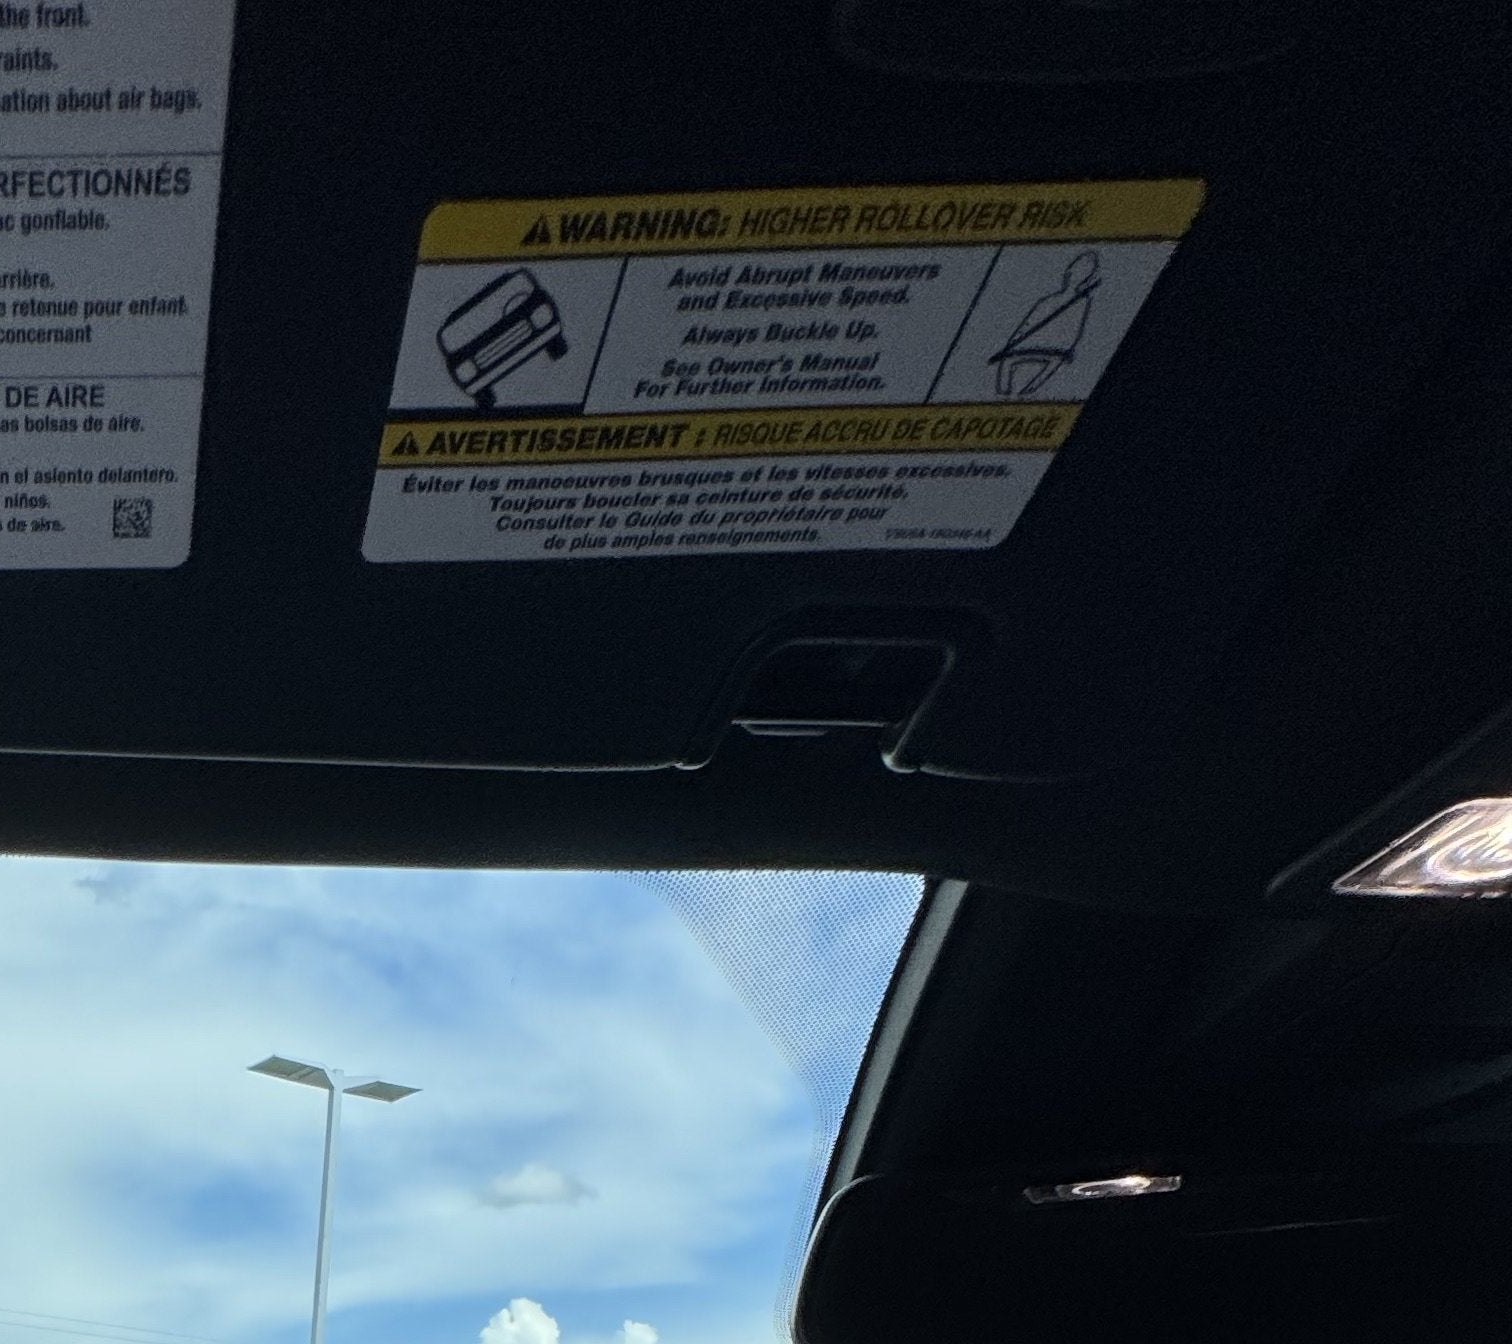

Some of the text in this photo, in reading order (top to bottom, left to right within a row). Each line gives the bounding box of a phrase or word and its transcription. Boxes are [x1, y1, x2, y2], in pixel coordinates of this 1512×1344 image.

[36, 2, 88, 30] front.
[56, 88, 112, 114] about
[117, 87, 143, 112] air
[149, 87, 201, 114] bags.
[558, 199, 1087, 243] WARNING: HIGHER ROLLOVER RISK
[669, 261, 940, 289] Avoid Abrupt Maneuvers
[677, 285, 911, 313] and Excessive Speed.
[683, 319, 879, 347] Always Buckle Up.
[659, 352, 878, 380] See Owner's Manual
[4, 383, 39, 409] DE
[46, 382, 105, 409] AIRE
[634, 372, 885, 399] For Further Information.
[426, 416, 1055, 456] AVERTISSEMENT RISQUE ACCRU DE CAPOTAGE
